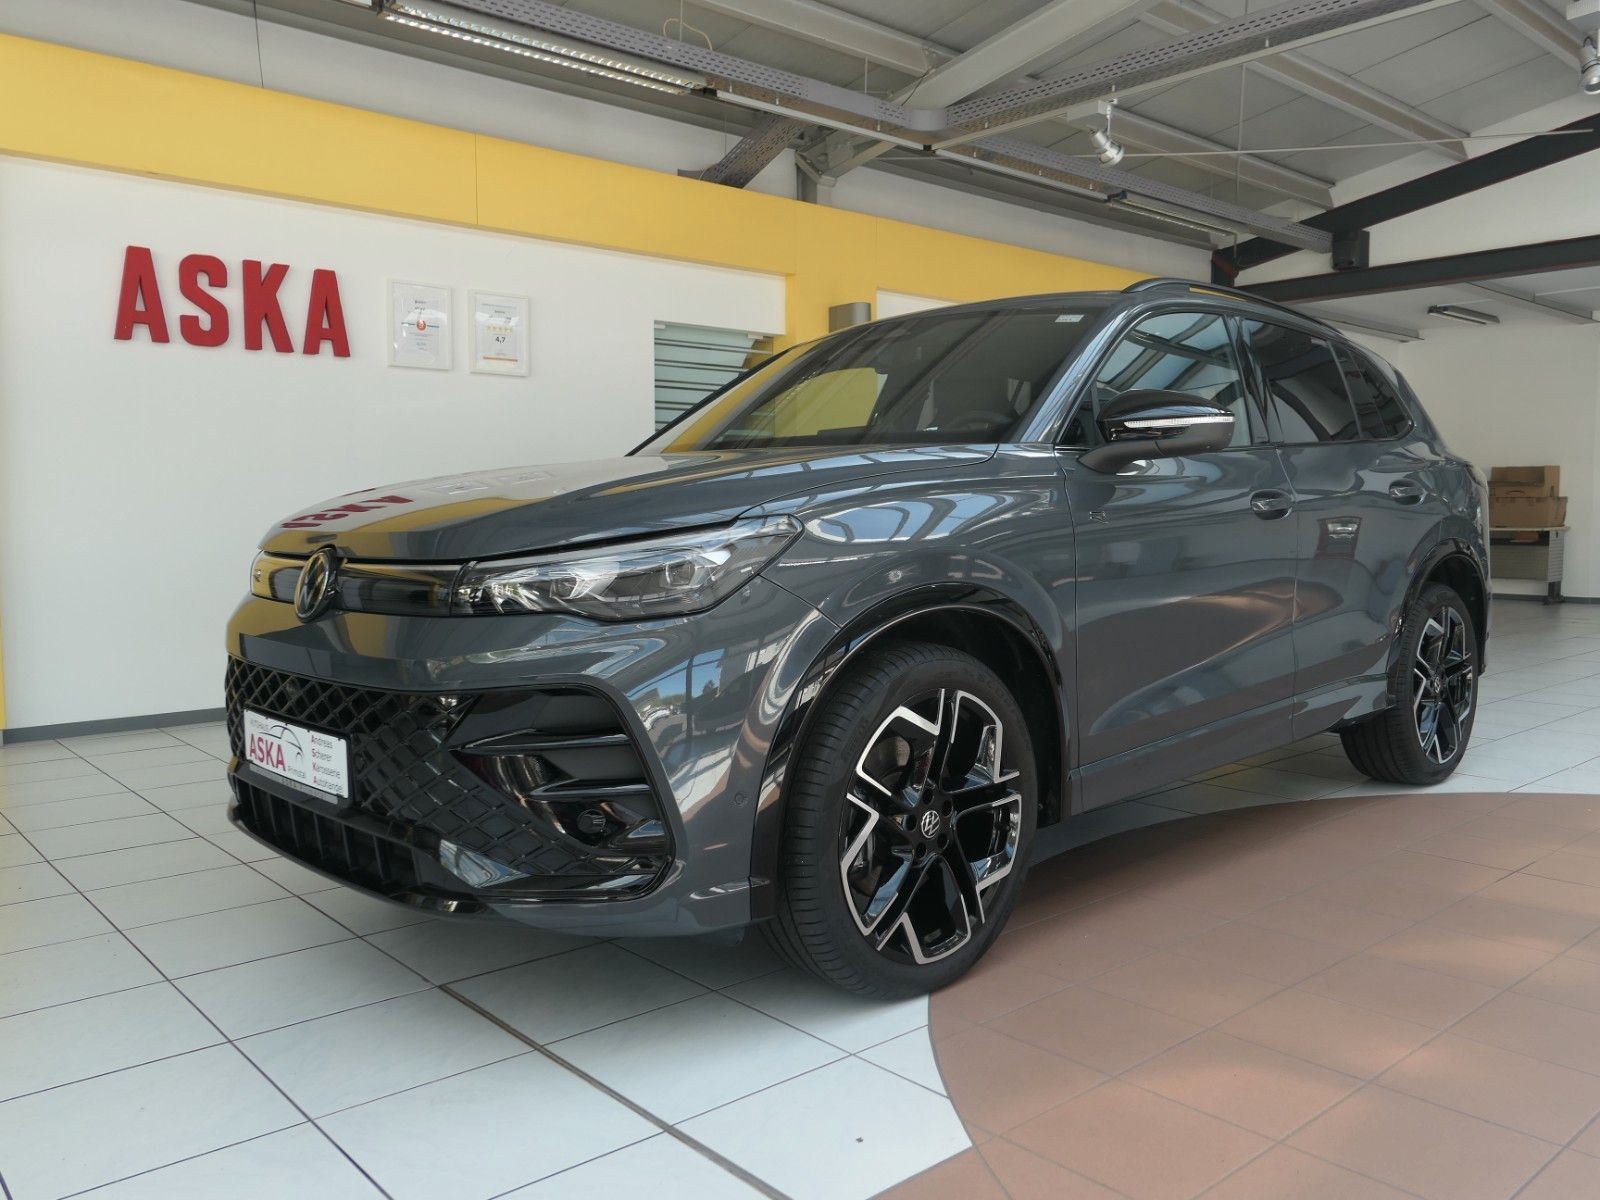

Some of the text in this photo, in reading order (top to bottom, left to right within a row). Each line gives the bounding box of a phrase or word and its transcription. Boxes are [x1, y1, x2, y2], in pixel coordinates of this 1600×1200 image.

[114, 245, 351, 357] ASKA
[495, 336, 506, 344] 4,7
[249, 733, 287, 772] ASKA
